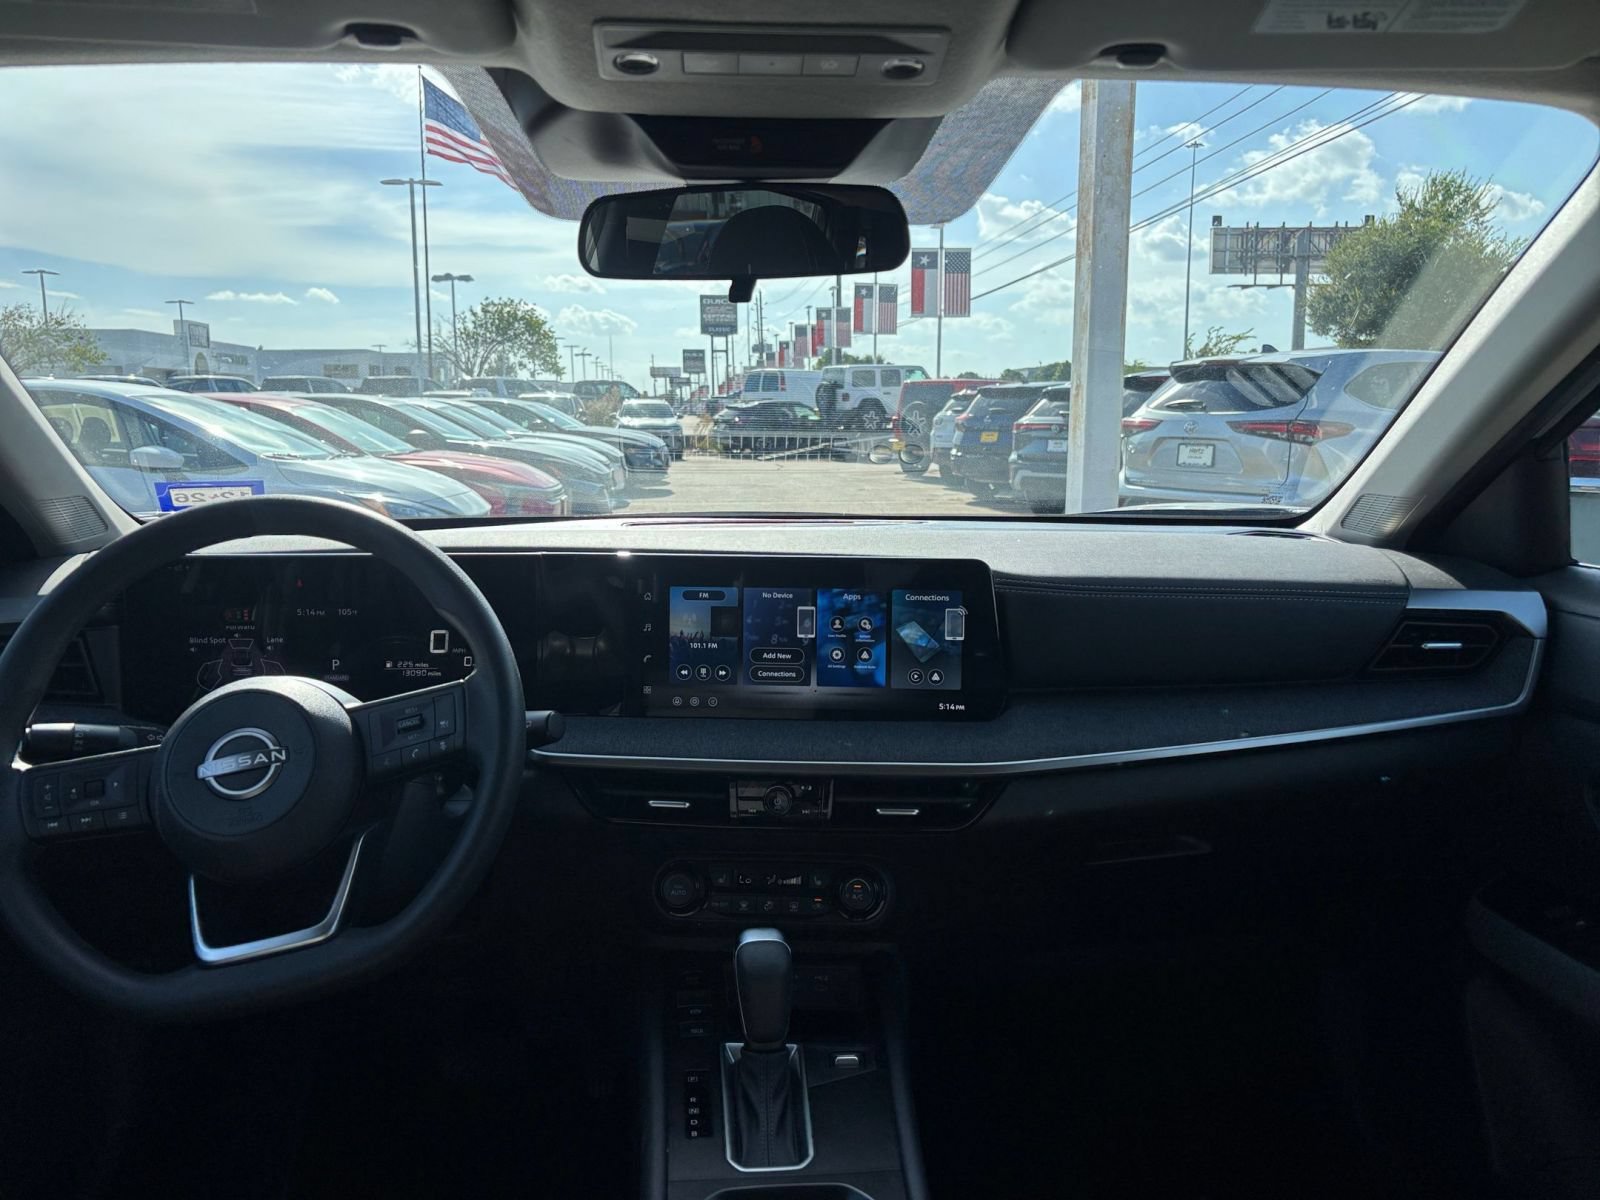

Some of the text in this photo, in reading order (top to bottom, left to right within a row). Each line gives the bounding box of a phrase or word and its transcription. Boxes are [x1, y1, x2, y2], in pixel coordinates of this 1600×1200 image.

[842, 593, 862, 601] Apps
[905, 593, 950, 602] Connections
[296, 608, 316, 616] 5:14
[188, 636, 227, 646] Blind Spot
[266, 636, 284, 644] Lane
[429, 629, 450, 654] 0
[762, 652, 792, 660] Add New
[332, 659, 340, 671] P
[757, 670, 796, 678] Connections
[938, 702, 955, 711] 5:14
[199, 749, 287, 777] NISSAN
[737, 874, 752, 884] Lo
